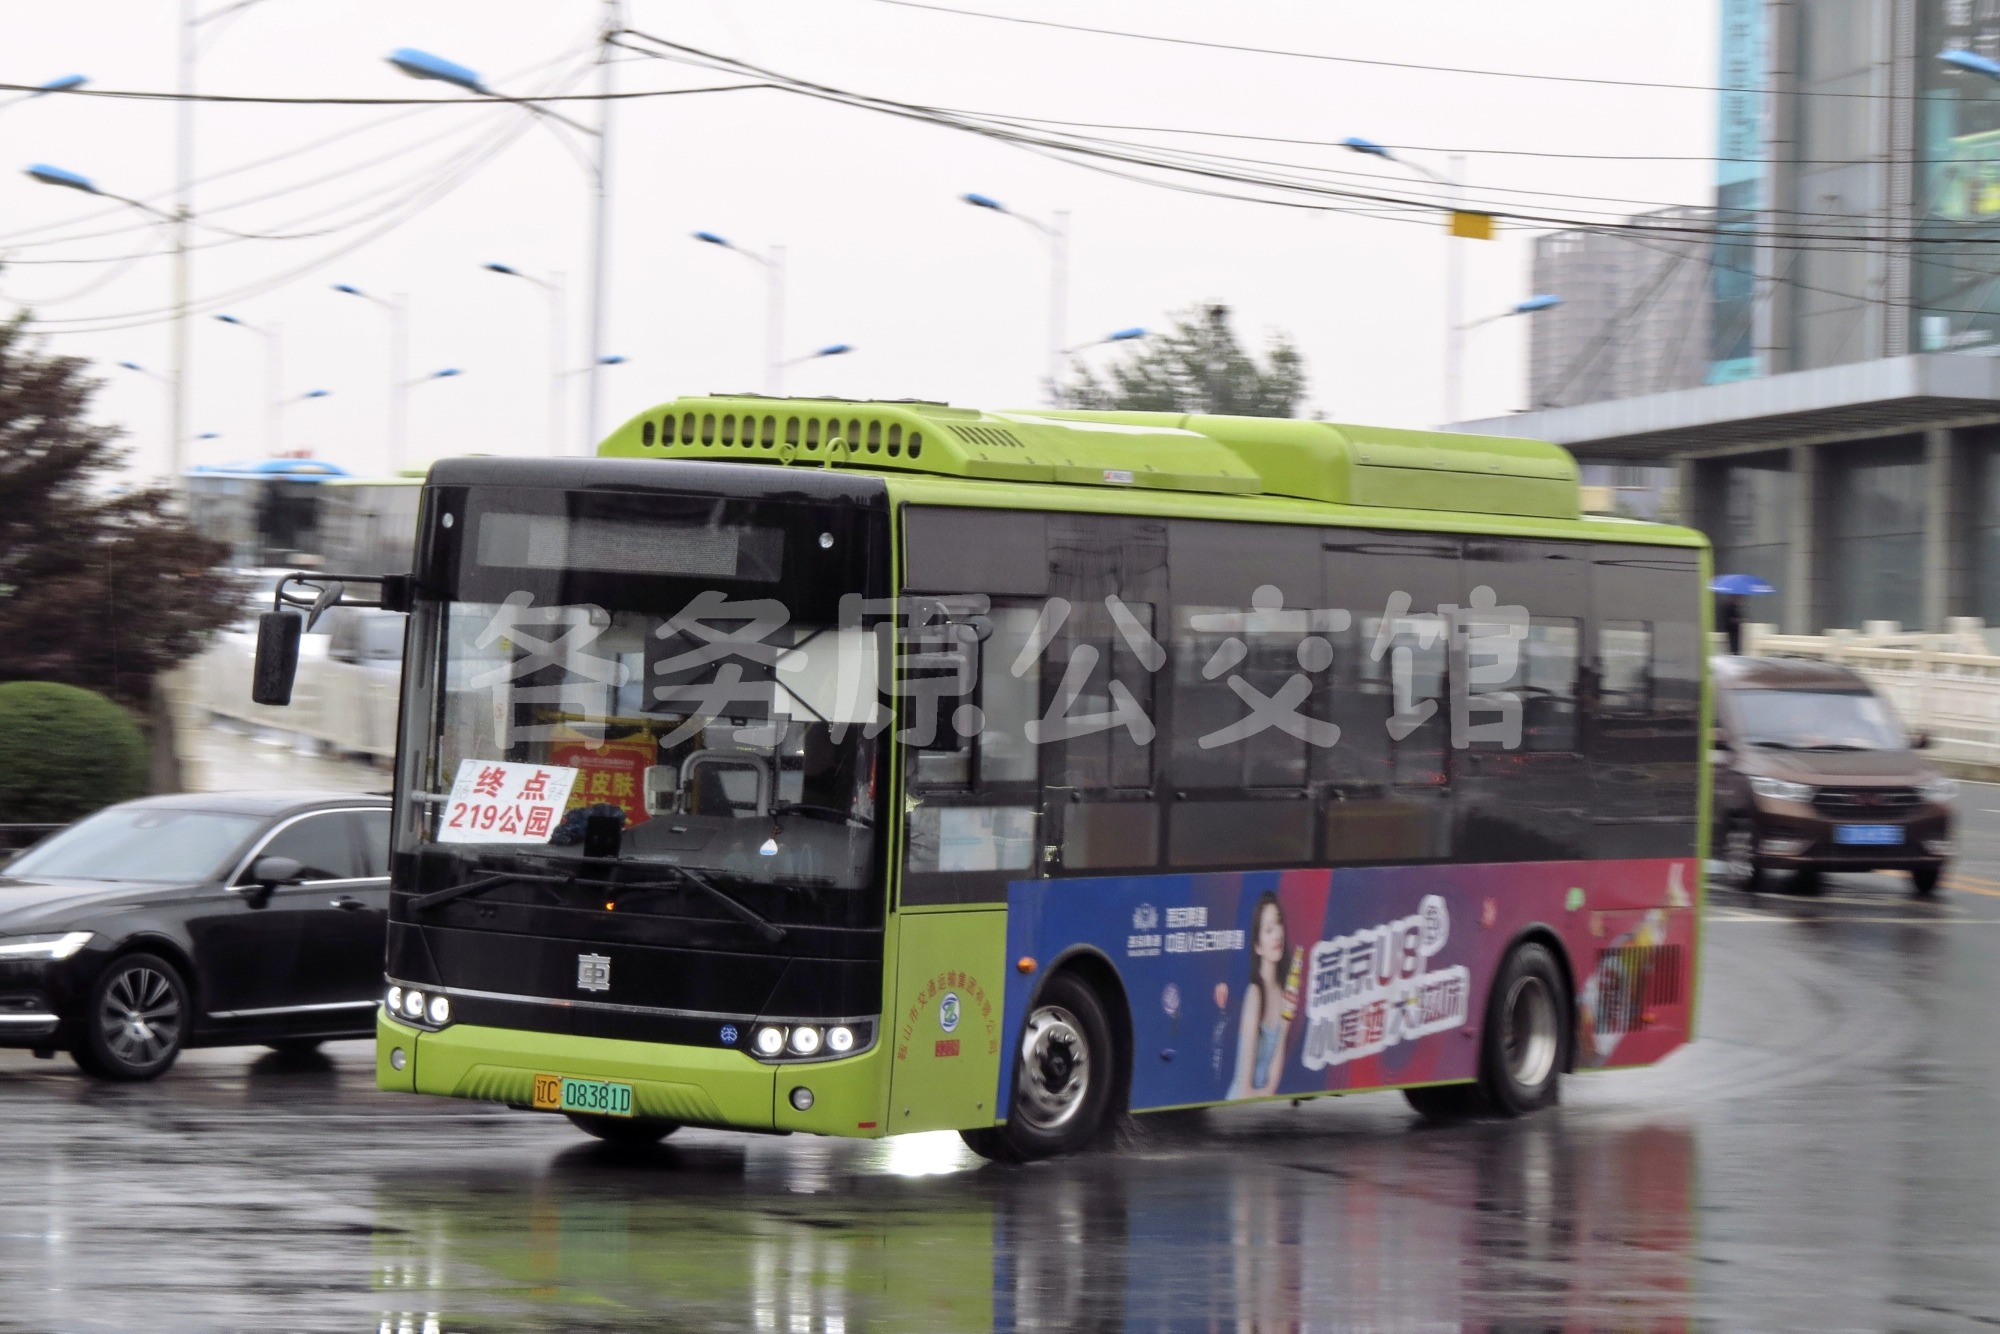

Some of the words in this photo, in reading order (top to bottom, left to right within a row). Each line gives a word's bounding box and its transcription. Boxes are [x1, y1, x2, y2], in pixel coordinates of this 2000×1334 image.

[473, 765, 551, 801] 终点
[449, 801, 555, 838] 219公园
[536, 1079, 558, 1104] 辽C
[565, 1082, 631, 1112] 08381D
